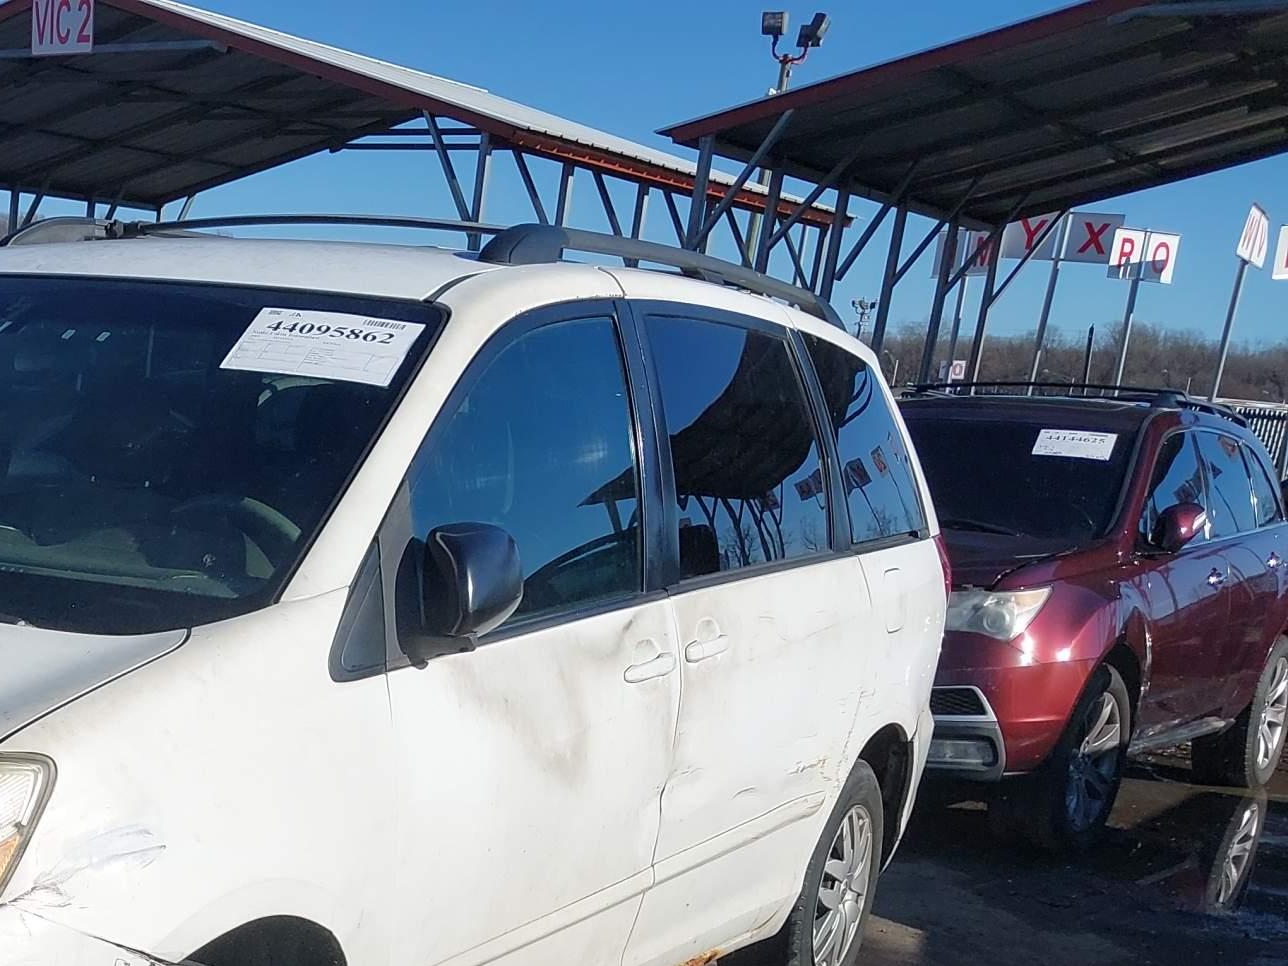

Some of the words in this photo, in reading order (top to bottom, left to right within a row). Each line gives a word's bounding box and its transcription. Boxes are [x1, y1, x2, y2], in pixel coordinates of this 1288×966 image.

[34, 0, 70, 46] VIC
[76, 0, 92, 43] 2
[1020, 216, 1049, 250] Y
[1076, 221, 1111, 255] X
[266, 319, 395, 345] 44095862
